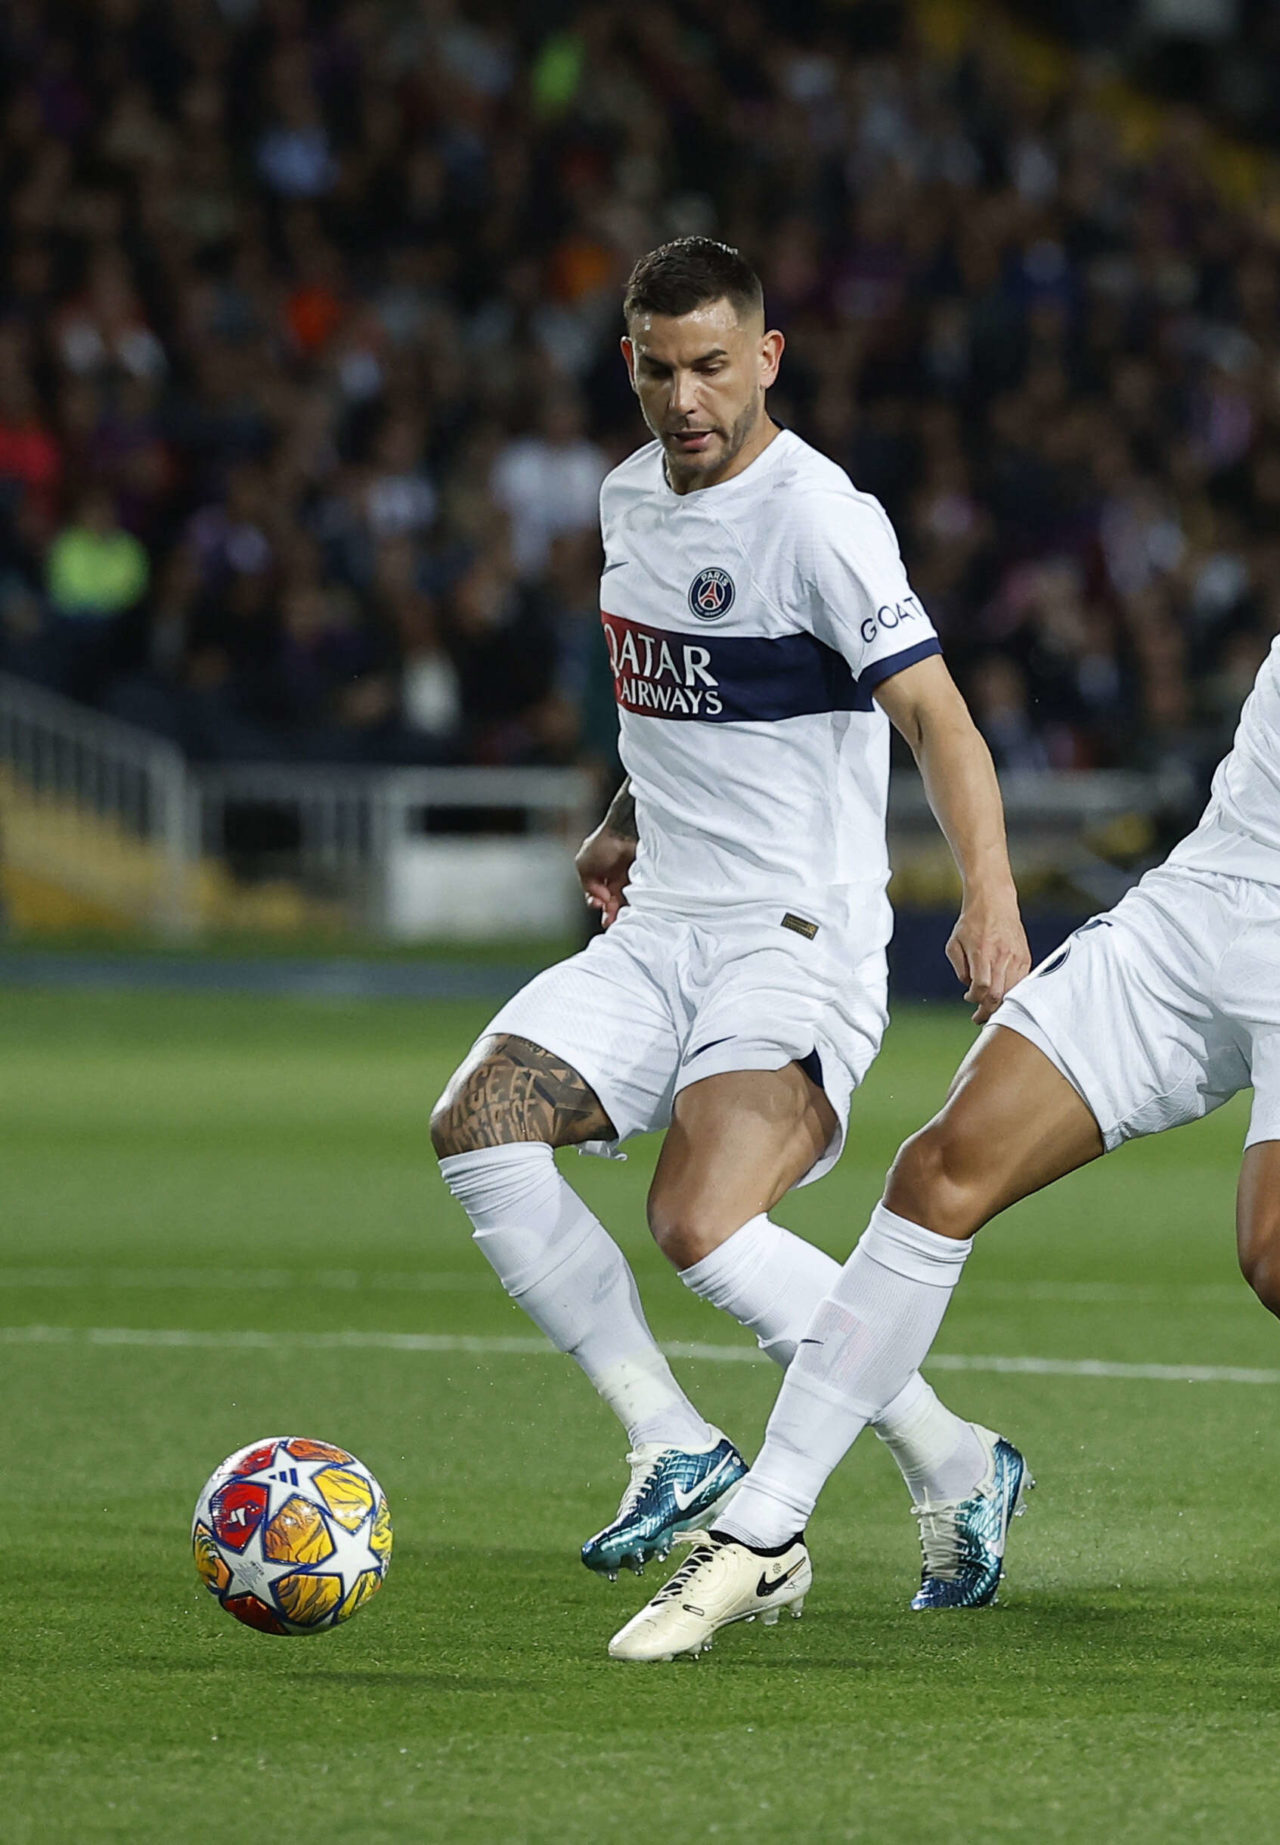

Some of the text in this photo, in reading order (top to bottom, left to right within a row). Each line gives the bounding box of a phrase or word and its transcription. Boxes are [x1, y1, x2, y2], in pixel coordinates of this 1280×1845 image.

[700, 571, 729, 587] PARIS
[861, 596, 923, 644] GOAT
[604, 623, 719, 687] QATAR
[620, 676, 724, 715] AIRWAYS
